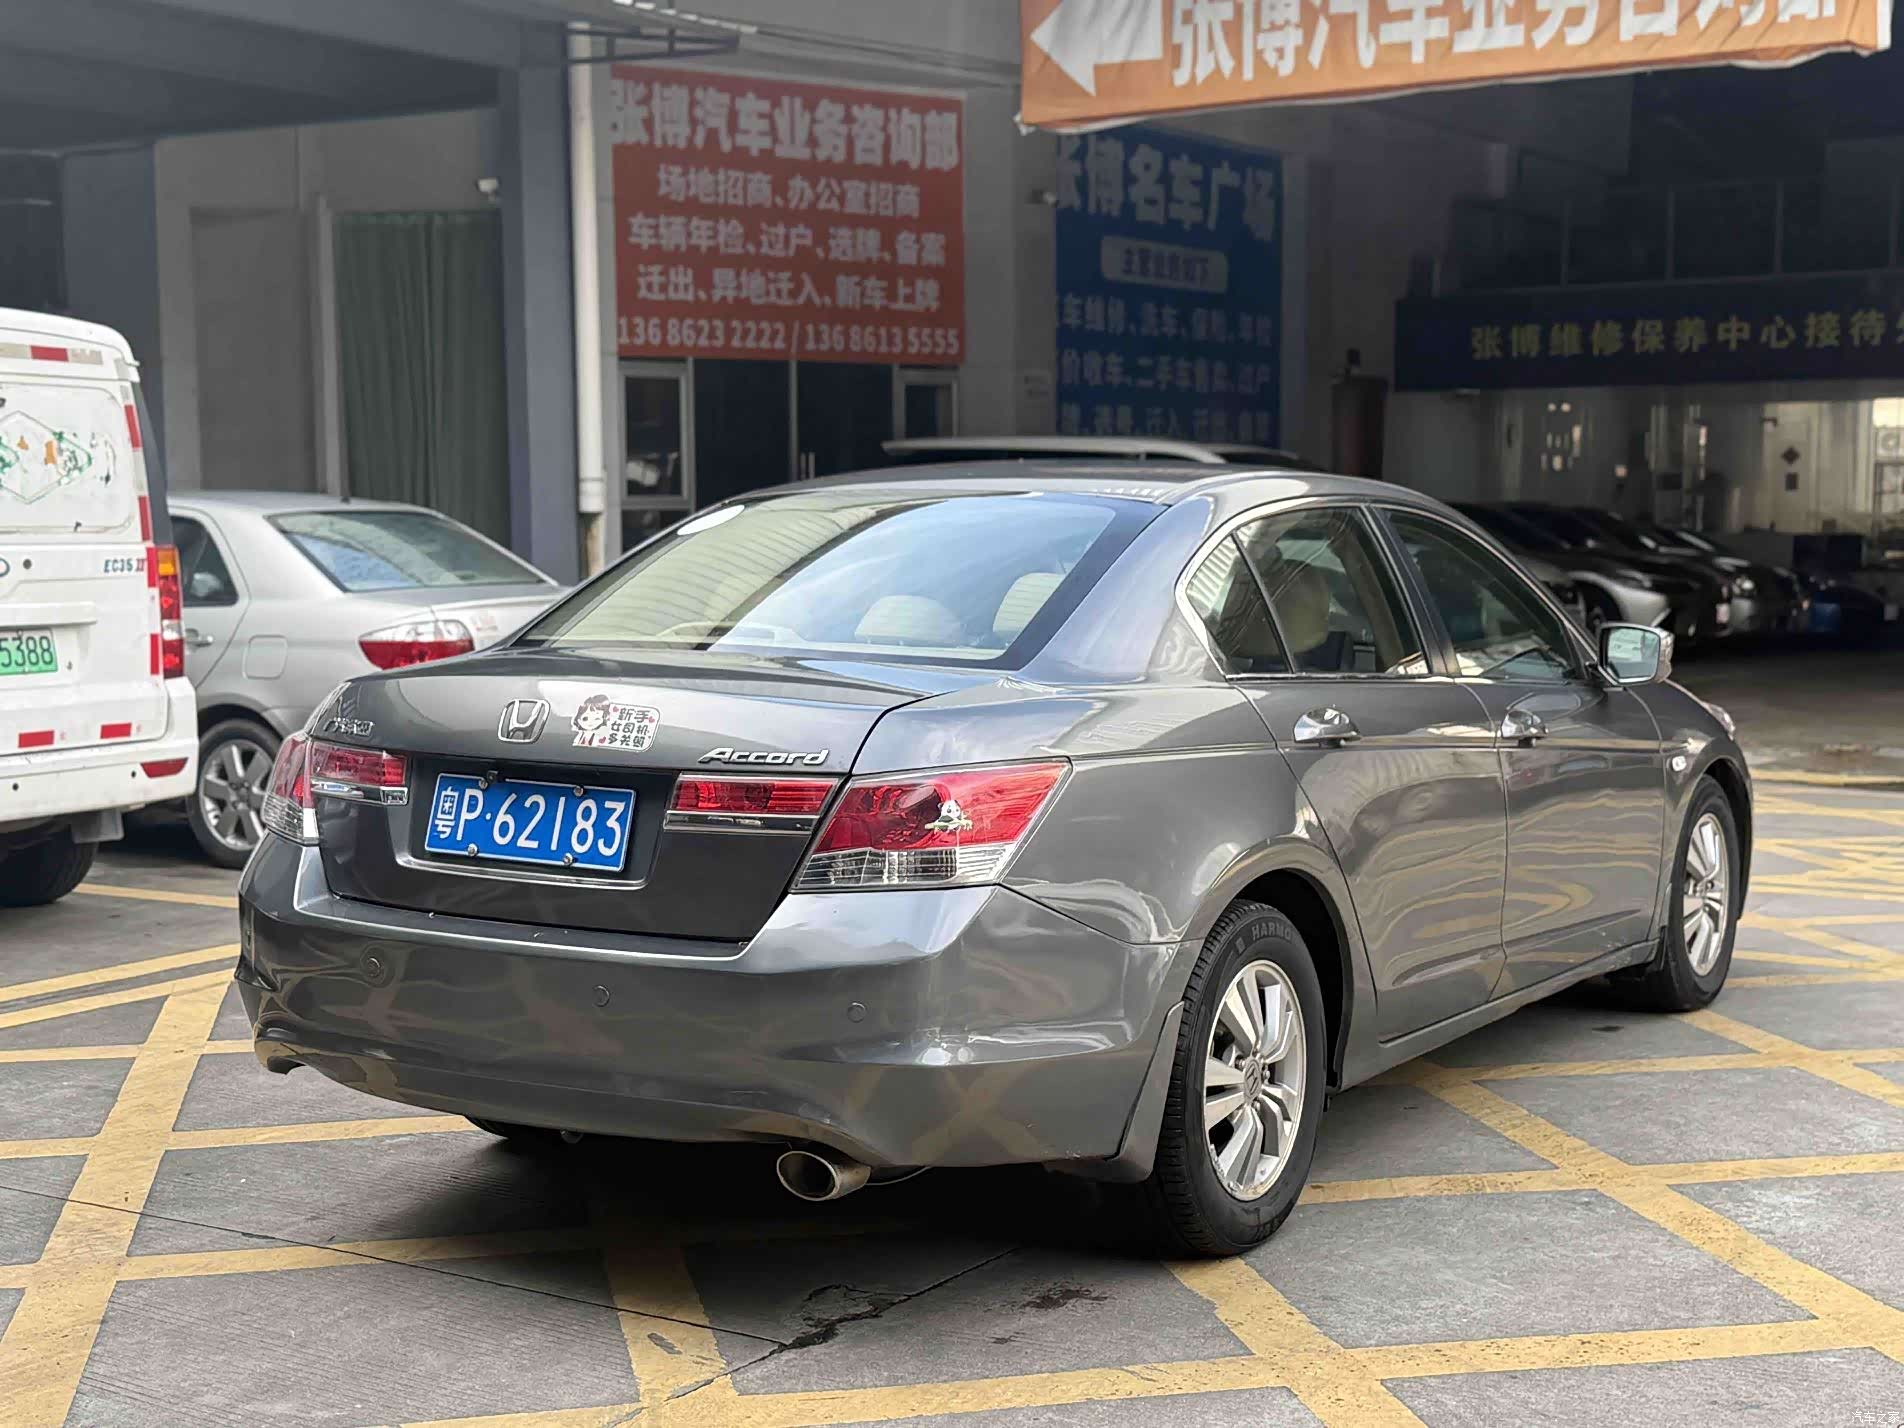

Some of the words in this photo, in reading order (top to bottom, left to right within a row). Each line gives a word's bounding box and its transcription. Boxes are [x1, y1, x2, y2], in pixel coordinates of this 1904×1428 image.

[610, 78, 960, 171] 张博汽车业务咨询部
[1471, 308, 1904, 360] 张博维修保养中心接待
[618, 707, 650, 723] 新手
[611, 721, 648, 735] 女司机
[608, 733, 645, 748] 多关照
[697, 747, 829, 765] Accord
